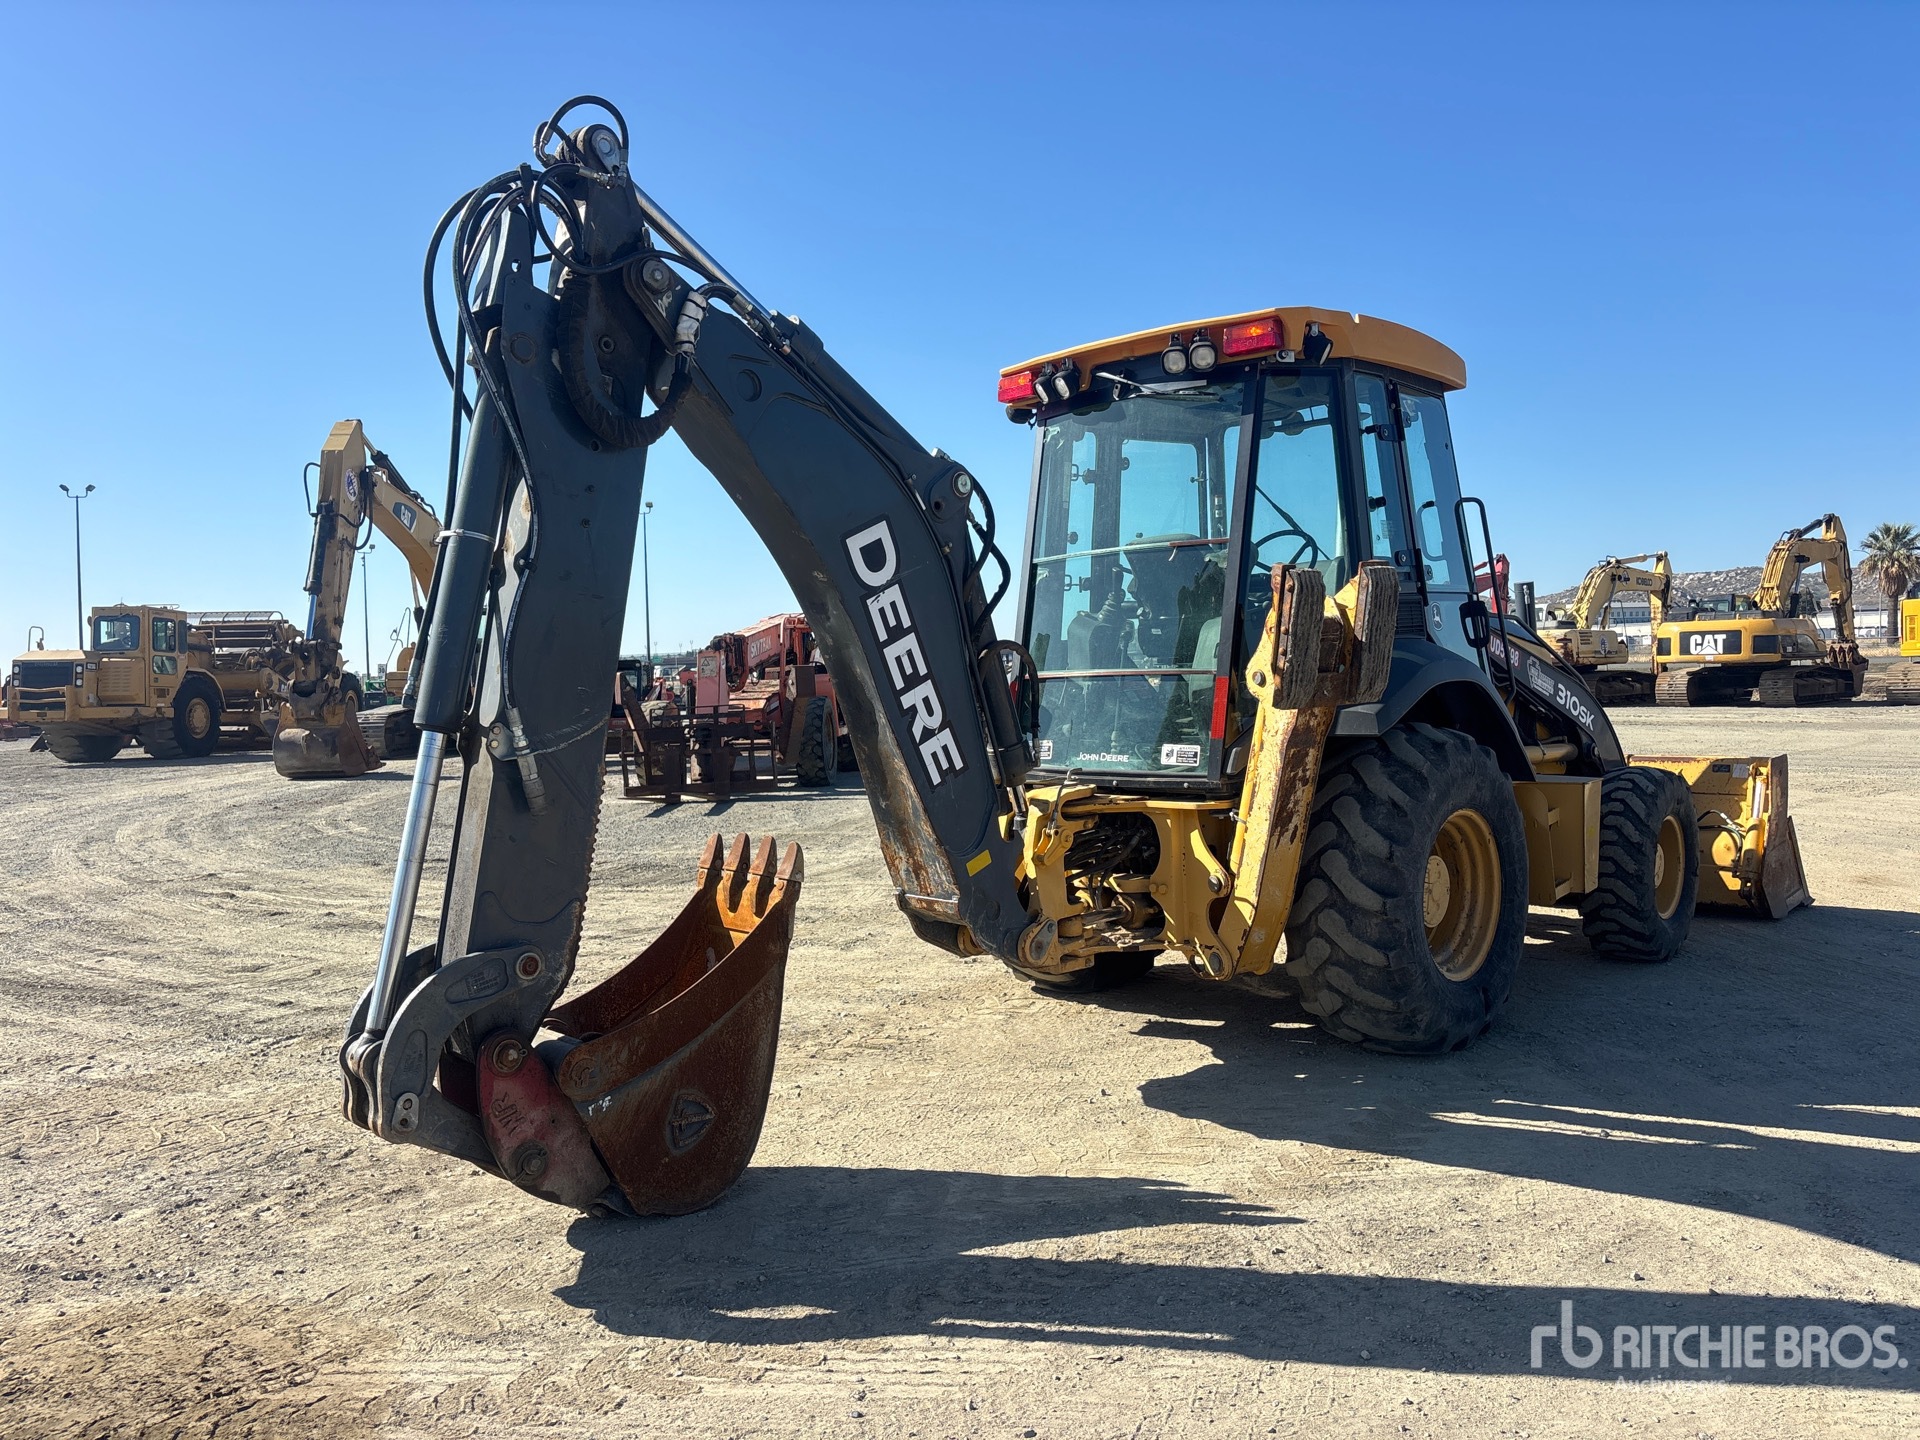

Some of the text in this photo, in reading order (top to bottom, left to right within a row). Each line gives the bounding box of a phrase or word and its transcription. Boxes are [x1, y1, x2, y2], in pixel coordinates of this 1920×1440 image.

[401, 504, 412, 528] CAT
[845, 520, 964, 786] DEERE
[1489, 634, 1520, 668] UD598
[1689, 633, 1727, 655] CAT
[1556, 682, 1596, 731] 310SK
[1076, 752, 1130, 763] JOHN DEERE
